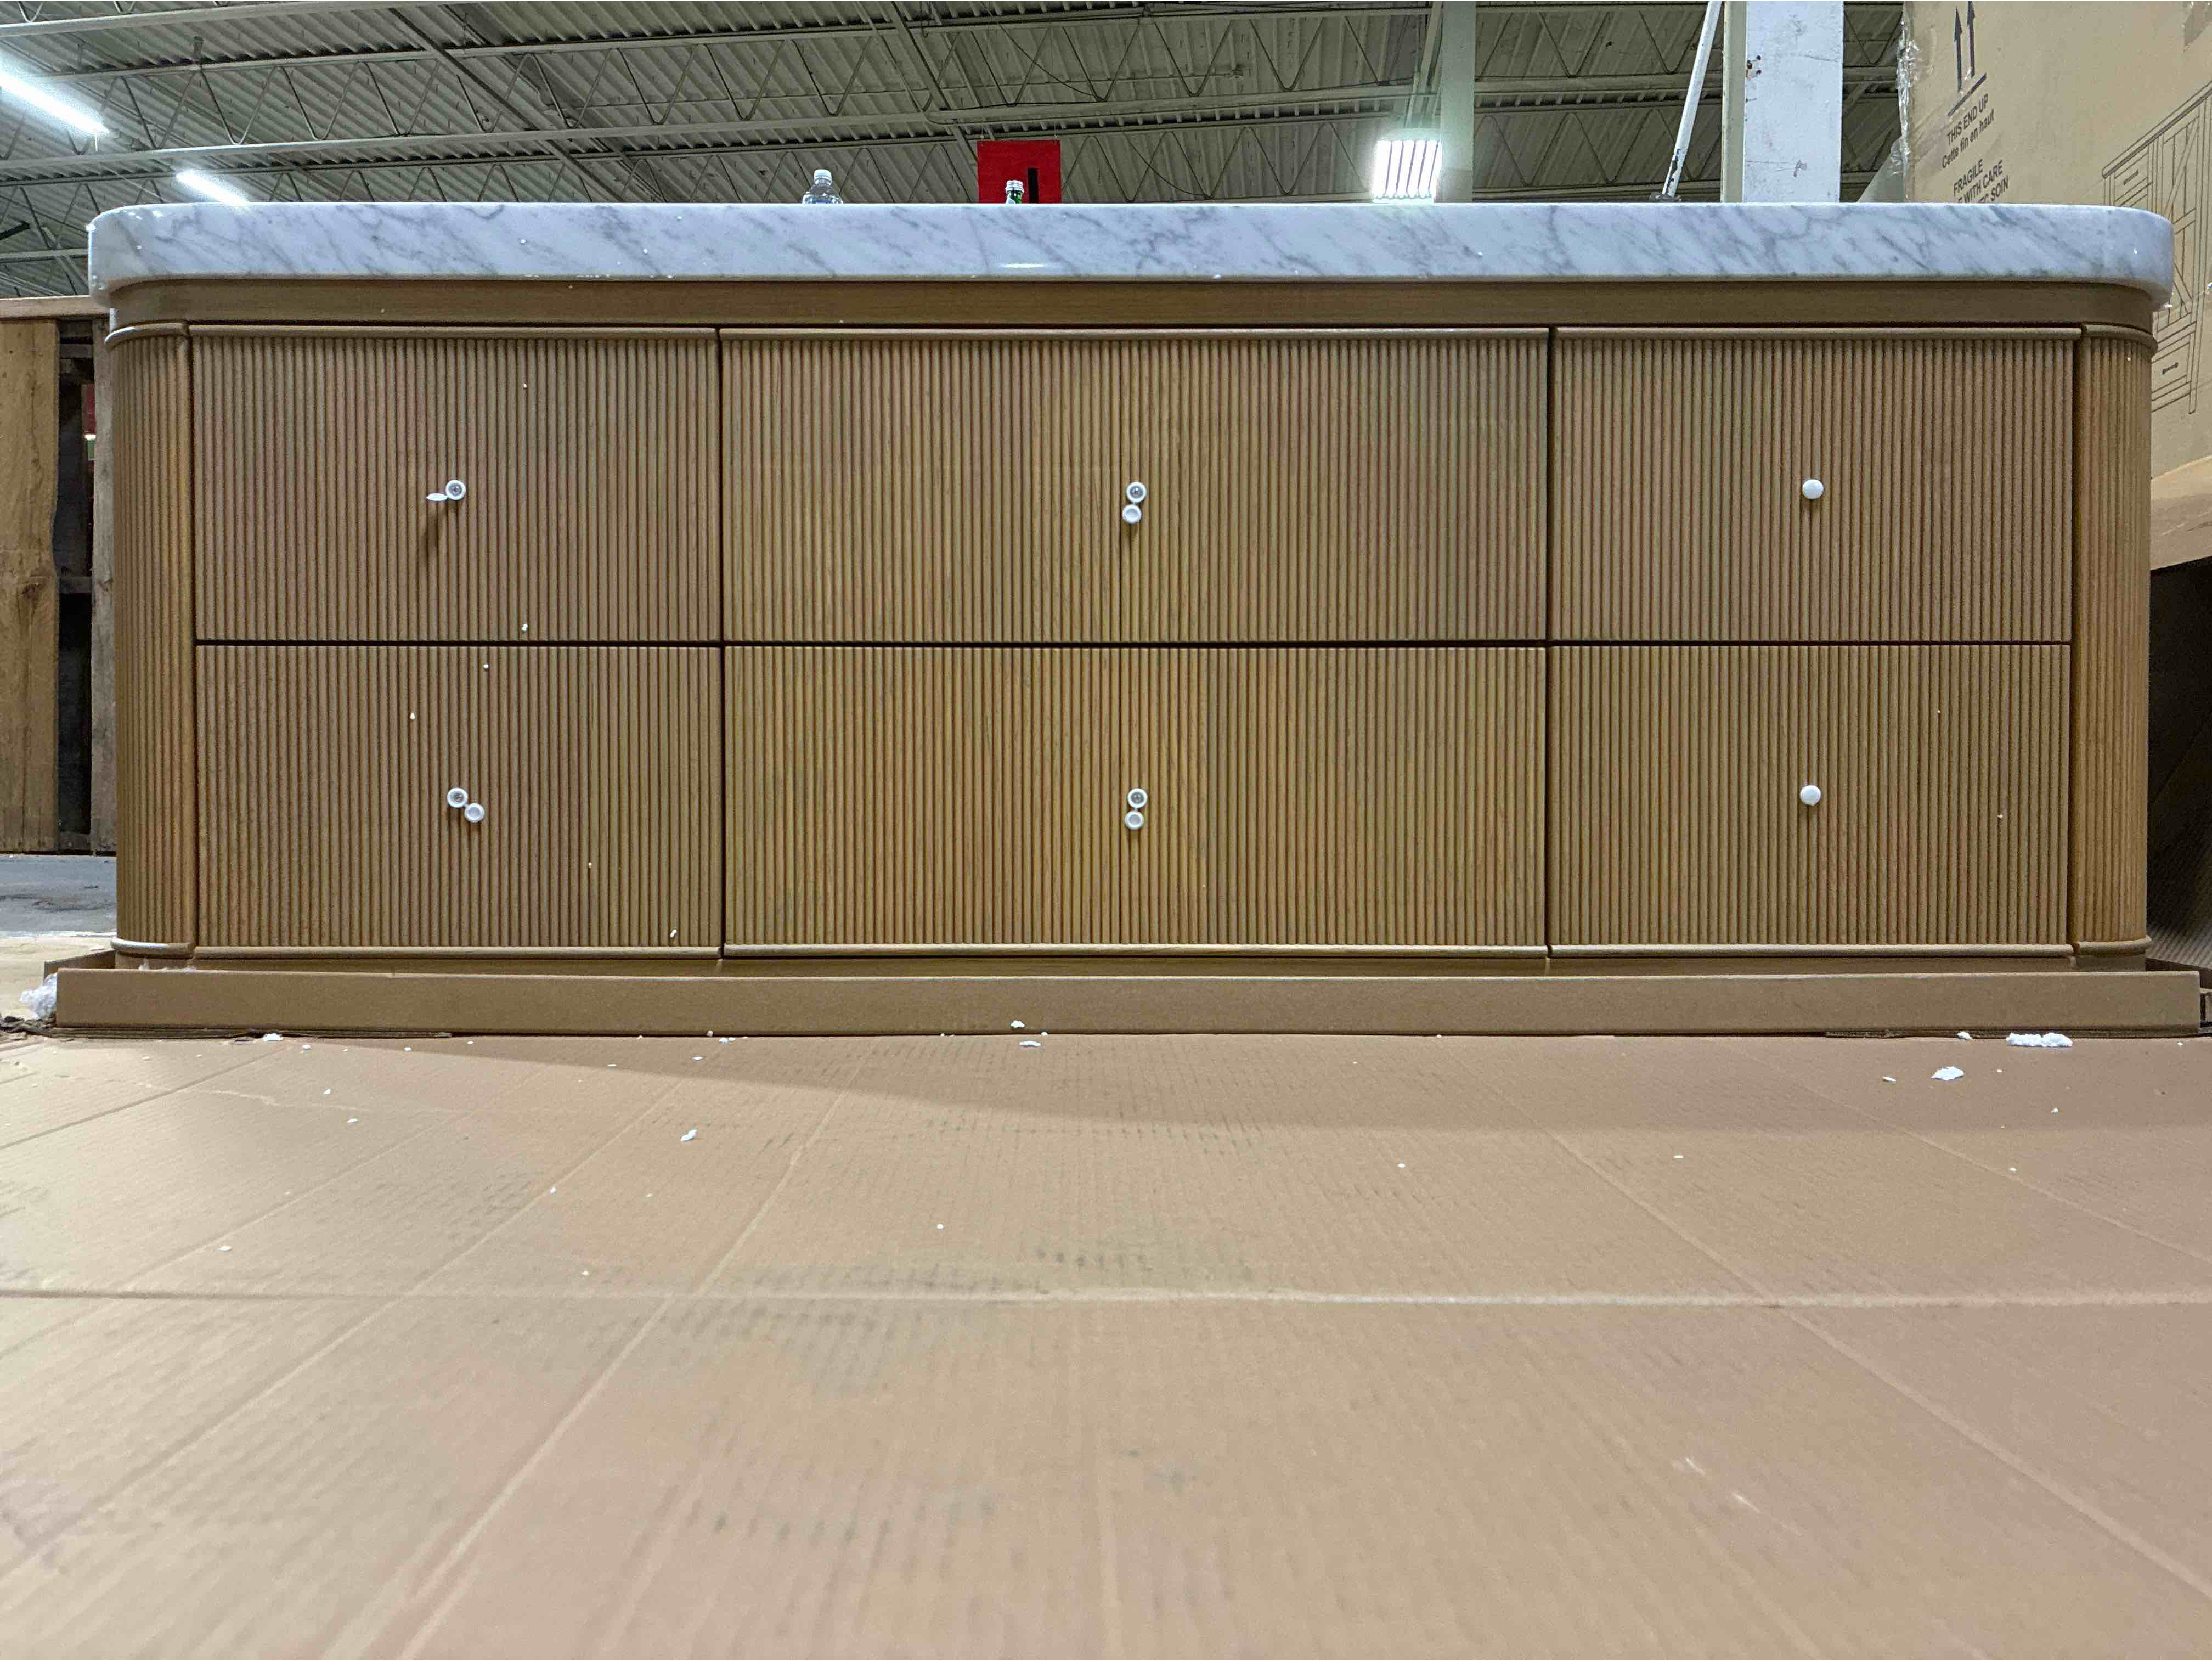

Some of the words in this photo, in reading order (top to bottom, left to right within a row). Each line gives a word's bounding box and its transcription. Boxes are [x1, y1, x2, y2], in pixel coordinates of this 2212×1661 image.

[1942, 147, 1959, 168] Cette
[1960, 137, 1968, 152] fin
[1970, 127, 1978, 142] en
[1979, 108, 1994, 133] haut
[1947, 121, 1962, 145] THIS
[1963, 105, 1978, 129] END
[1979, 93, 1988, 113] UP
[1954, 159, 1983, 197] FRAGILE
[1964, 179, 1981, 203] WITH
[1983, 159, 2002, 189] CARE
[1990, 175, 2008, 202] SOIN
